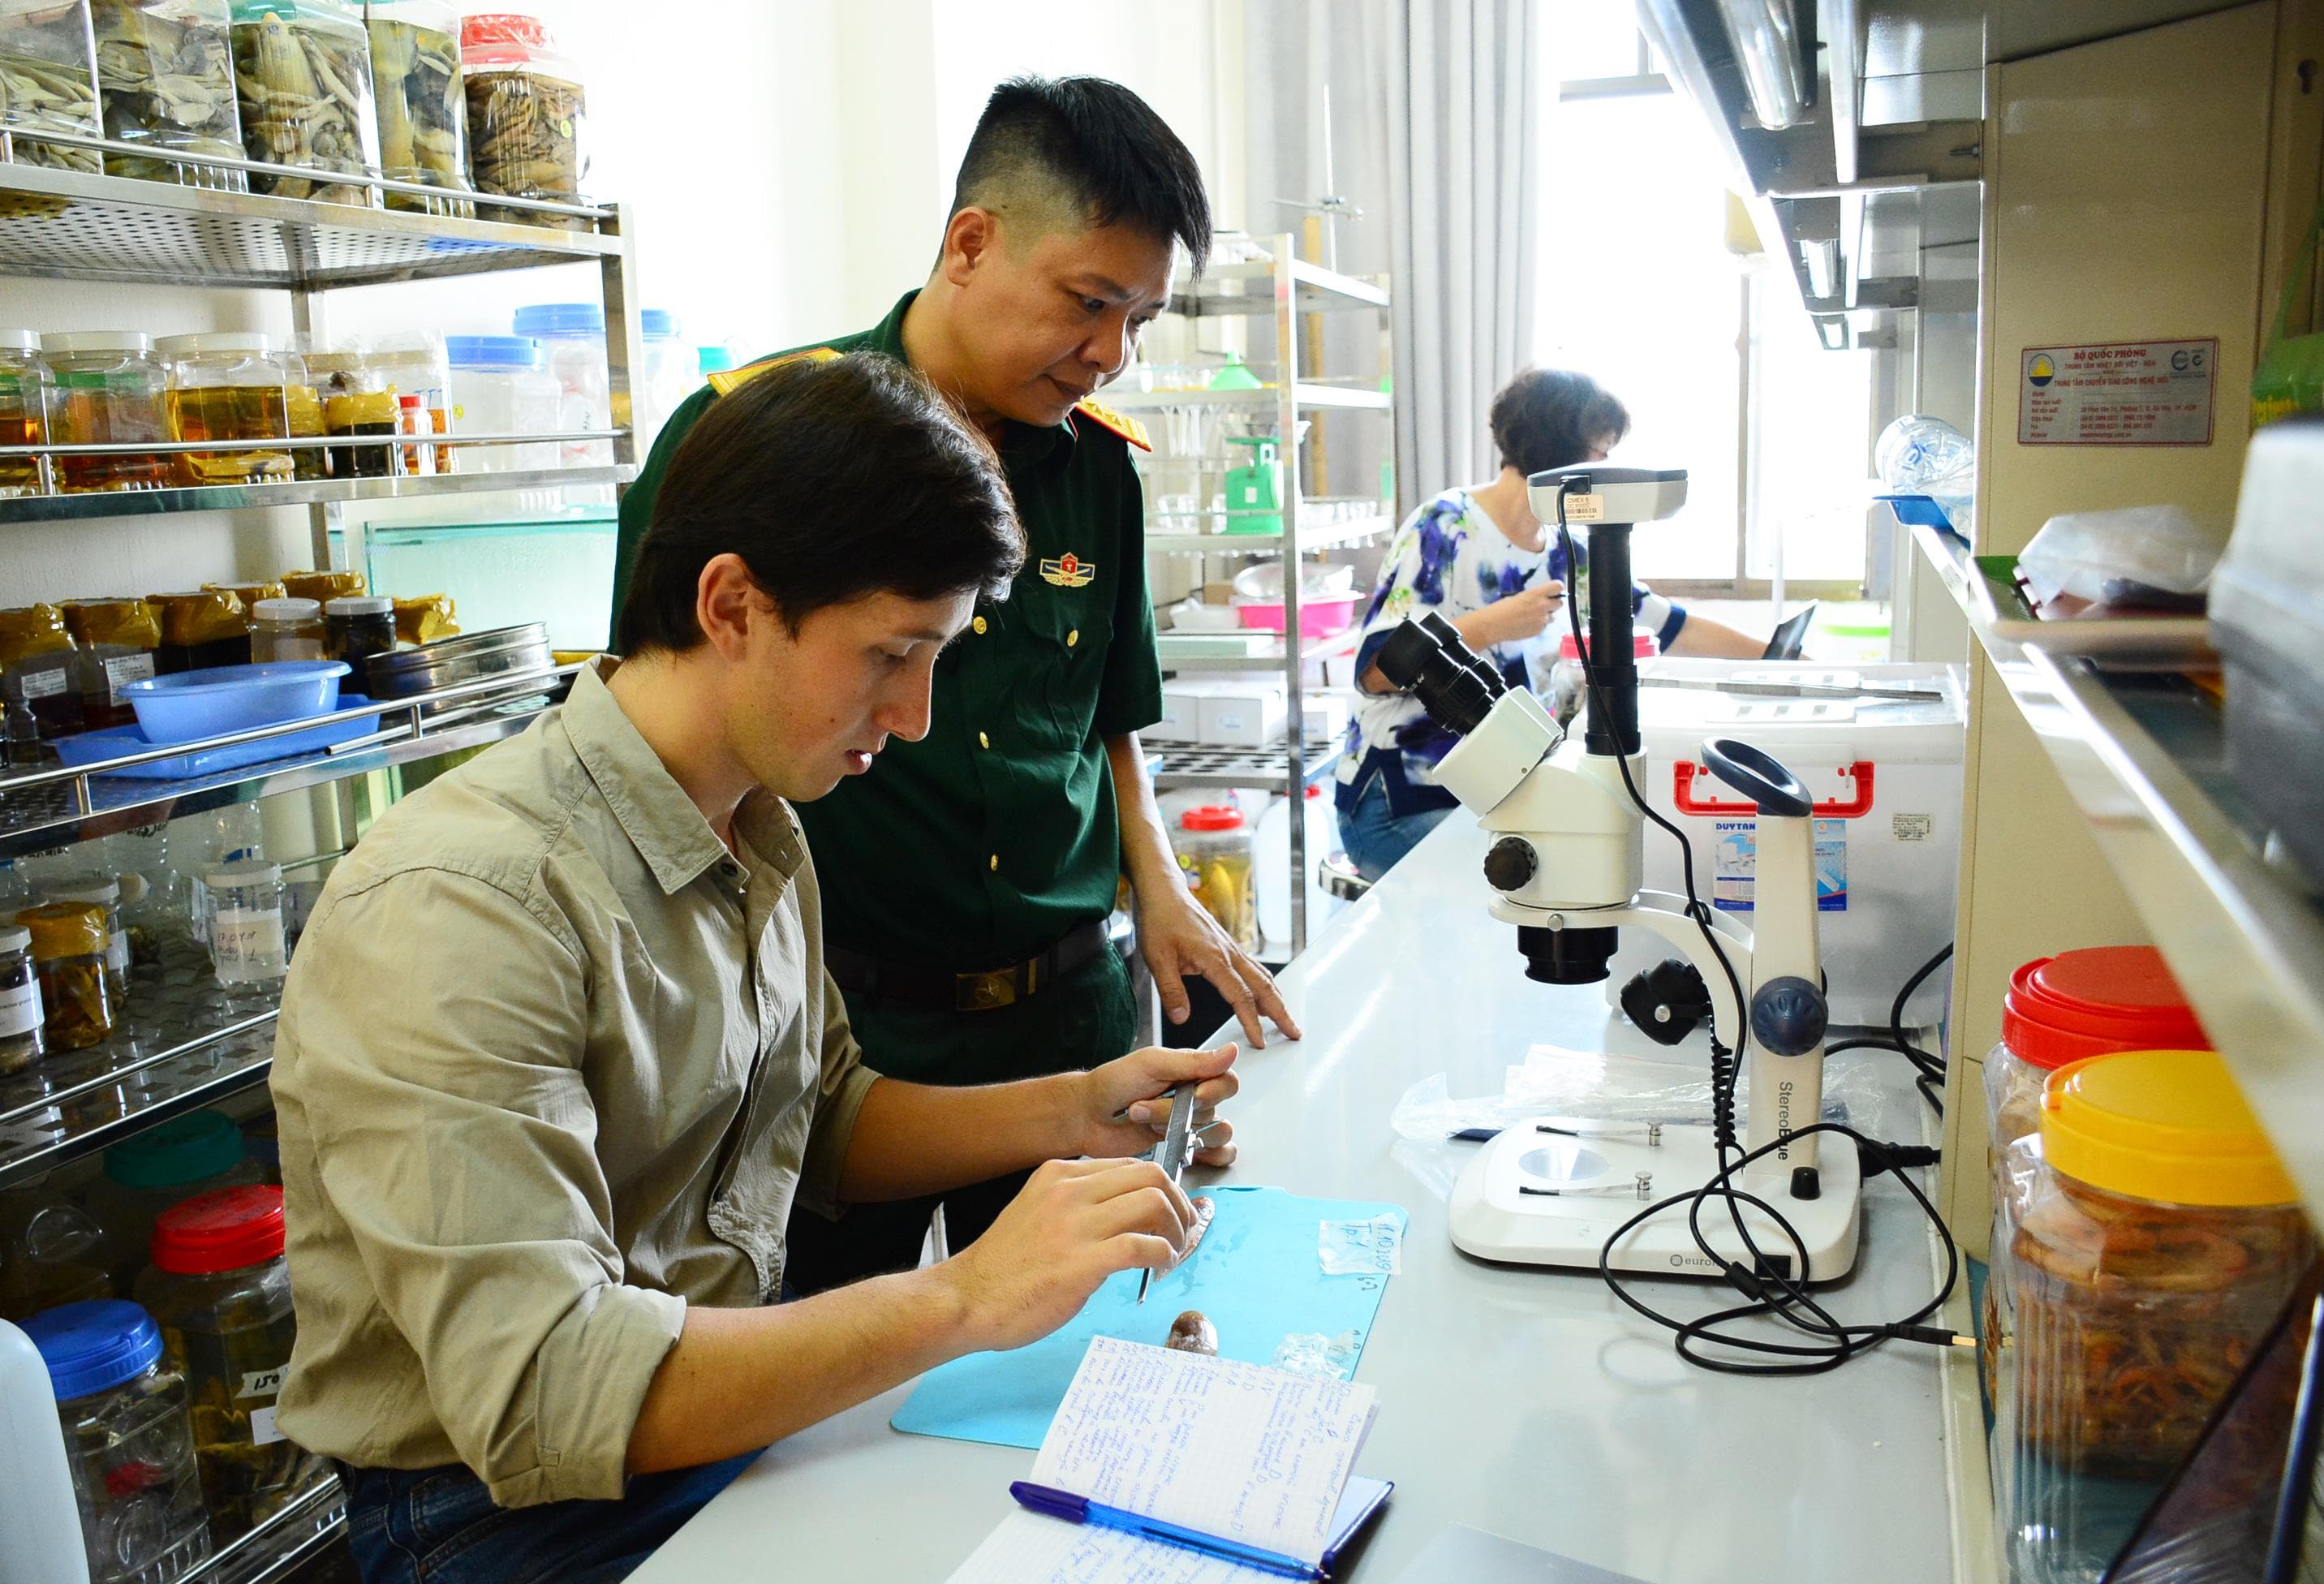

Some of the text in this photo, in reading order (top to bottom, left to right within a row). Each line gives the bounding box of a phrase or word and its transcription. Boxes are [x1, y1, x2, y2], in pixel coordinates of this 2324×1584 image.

[2073, 347, 2146, 360] BỘ QUỐC PHÒNG
[1778, 1081, 1793, 1160] StereoBue
